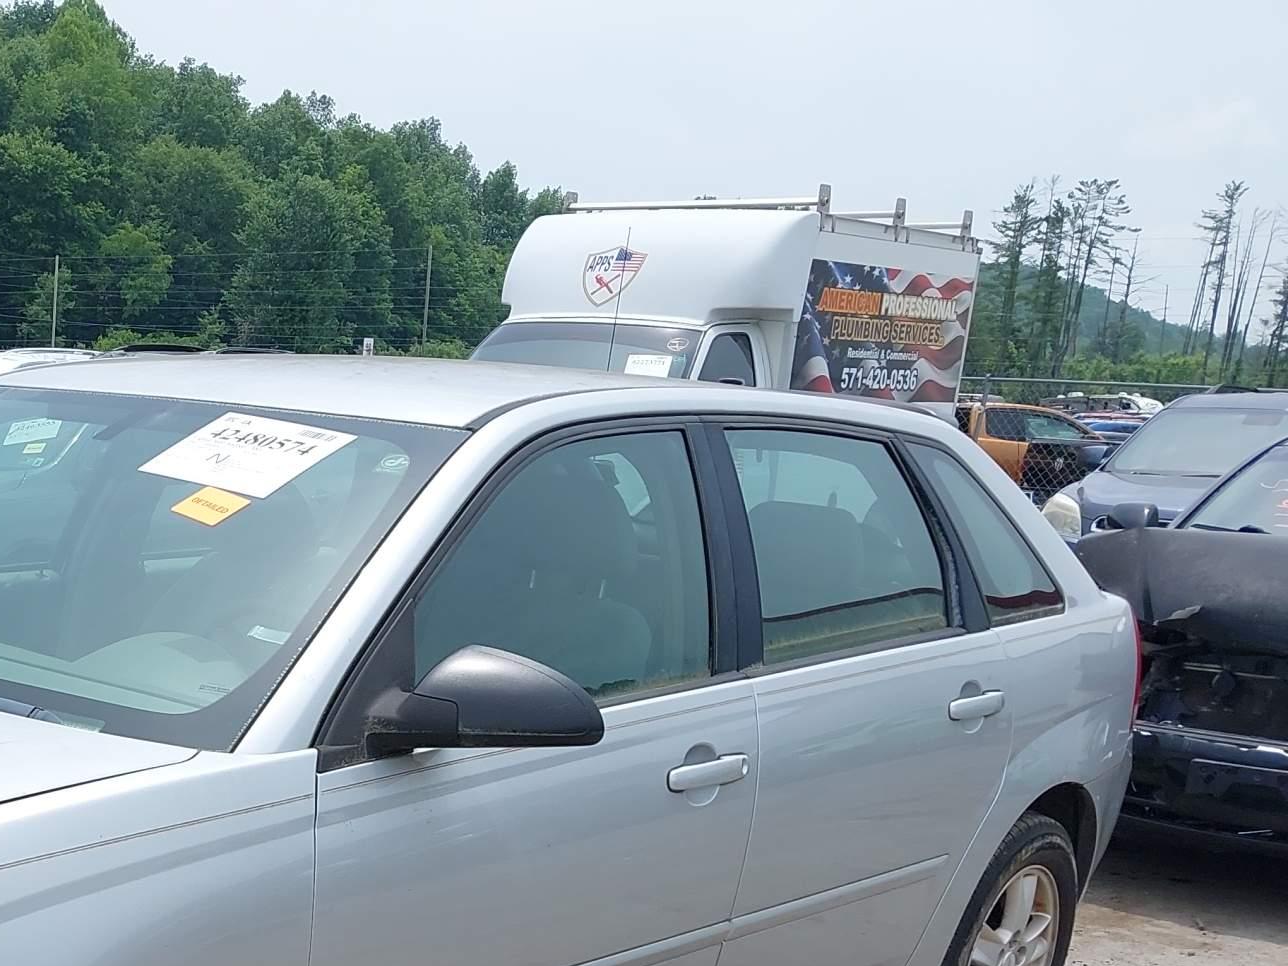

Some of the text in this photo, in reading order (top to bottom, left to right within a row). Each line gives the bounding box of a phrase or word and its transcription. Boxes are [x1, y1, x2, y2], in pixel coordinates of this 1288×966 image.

[586, 255, 614, 272] APPS
[817, 288, 958, 320] AMERICAN PROFESSIONAL
[831, 317, 890, 342] PLUMBING
[847, 347, 879, 359] Residential
[886, 350, 919, 360] Commercial
[841, 367, 918, 390] 571-420-0536
[211, 427, 318, 456] 42480574
[192, 497, 229, 513] DETAILED
